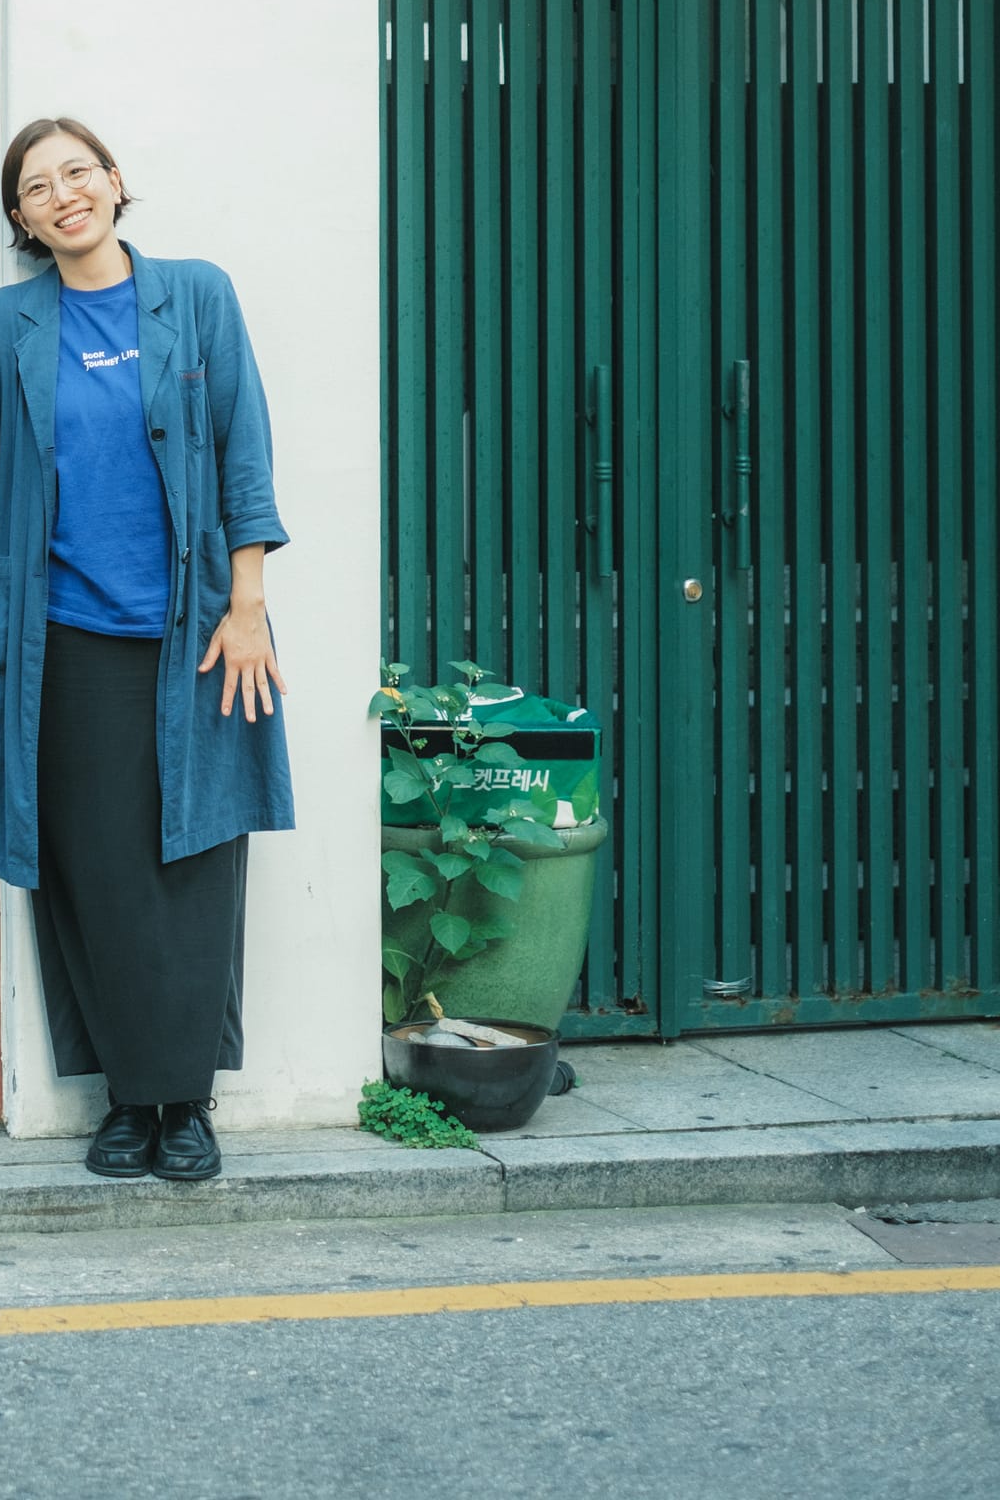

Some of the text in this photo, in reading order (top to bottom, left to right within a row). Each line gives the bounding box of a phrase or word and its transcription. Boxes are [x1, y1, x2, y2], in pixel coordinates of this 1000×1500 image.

[82, 351, 105, 360] BOOK
[121, 350, 140, 361] LIFE
[453, 768, 550, 793] 켓프레시
